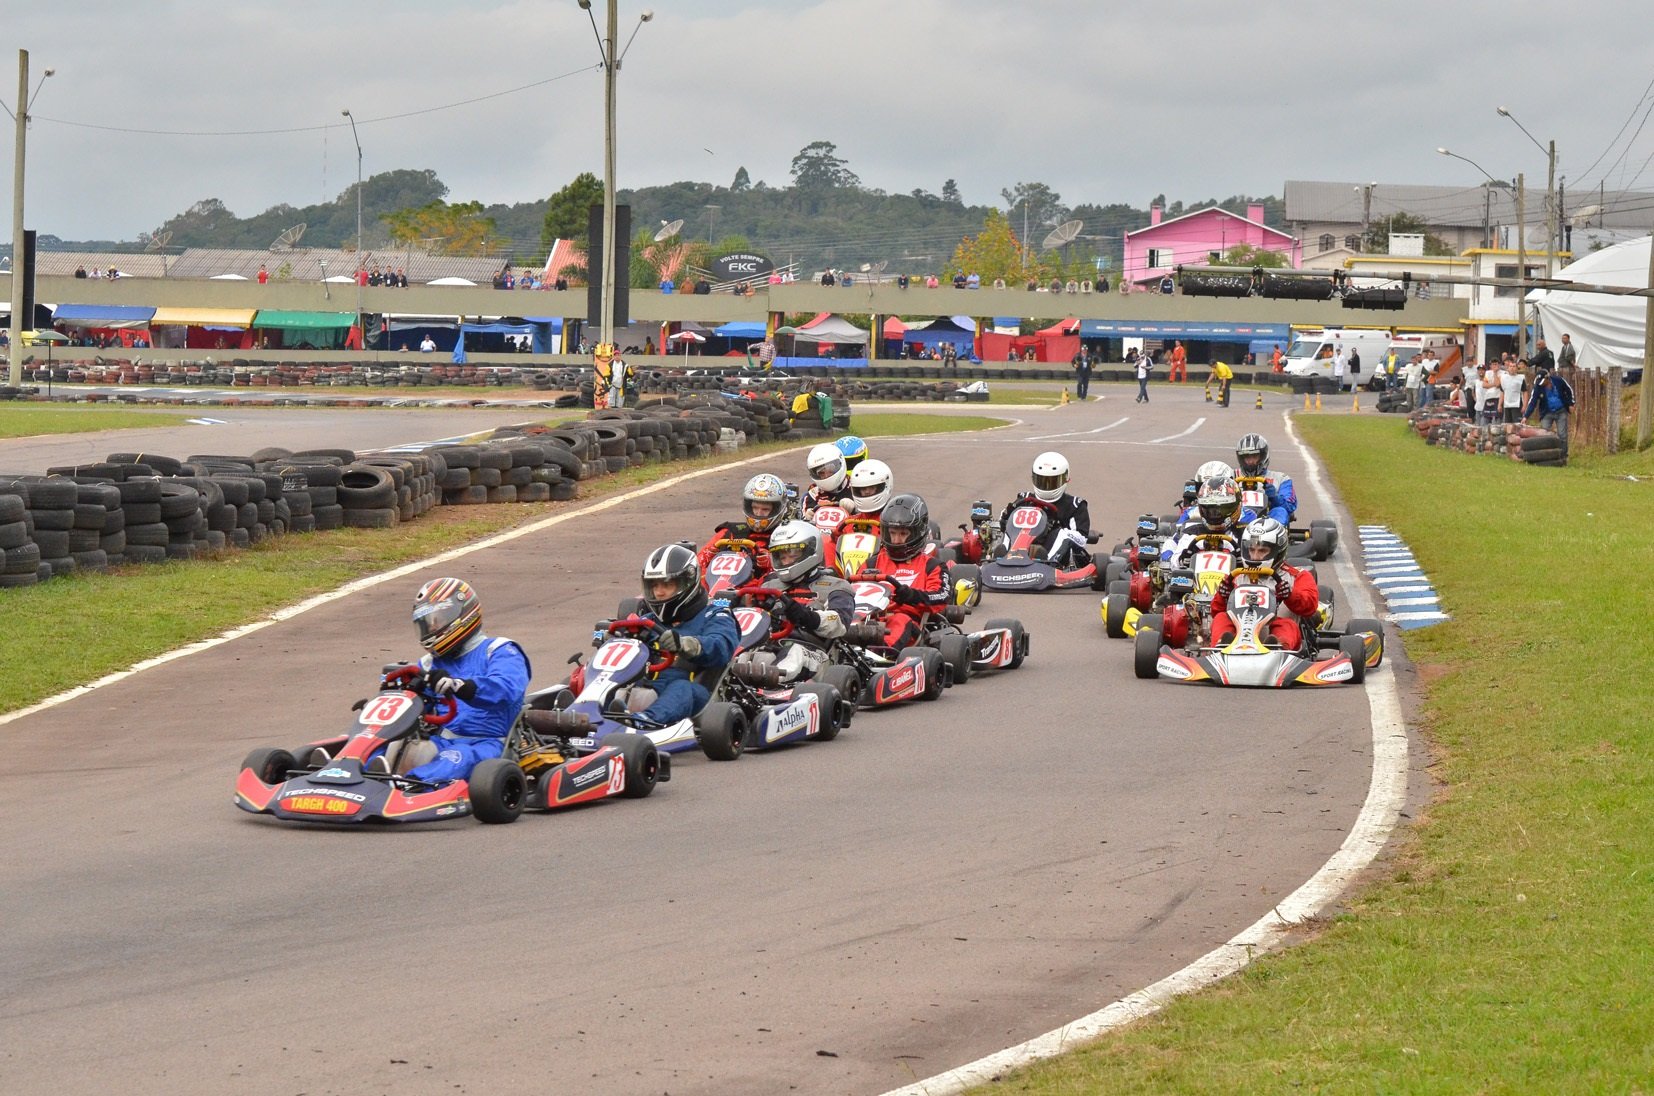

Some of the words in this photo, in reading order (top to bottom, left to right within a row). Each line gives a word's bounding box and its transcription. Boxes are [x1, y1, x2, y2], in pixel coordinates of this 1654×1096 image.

[720, 254, 739, 263] VOLTE
[740, 254, 764, 264] SEMPRE
[728, 262, 756, 271] FKC
[819, 511, 840, 522] 33
[1015, 510, 1039, 526] 88
[855, 535, 864, 548] 7
[713, 557, 741, 572] 221
[1203, 554, 1228, 570] 77
[992, 572, 1044, 581] TECHSPEED
[600, 643, 634, 667] 17
[916, 664, 924, 692] 10
[1158, 664, 1171, 672] SPORT
[1170, 666, 1189, 677] RACING
[1320, 671, 1338, 680] SPORT
[364, 697, 405, 721] 73
[808, 702, 818, 734] 17
[572, 765, 606, 784] TECHSPEED
[285, 788, 366, 802] TECHSPEED
[290, 797, 323, 811] TARGH
[326, 800, 348, 812] 400
